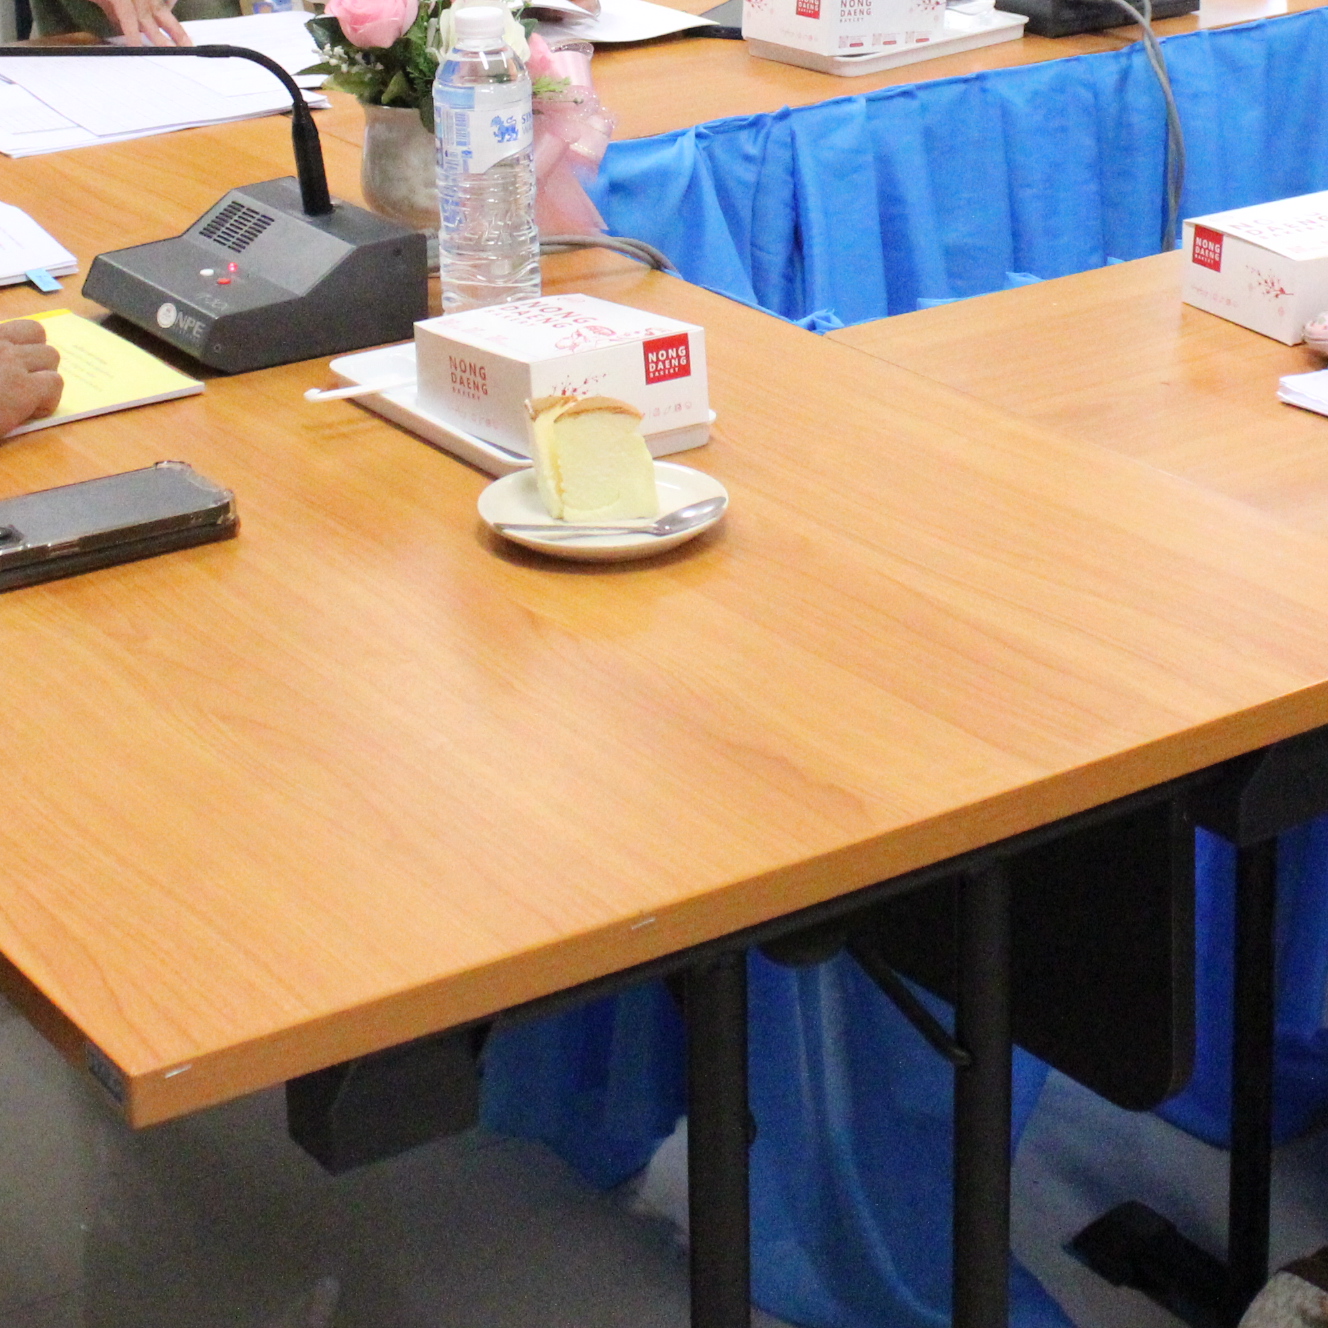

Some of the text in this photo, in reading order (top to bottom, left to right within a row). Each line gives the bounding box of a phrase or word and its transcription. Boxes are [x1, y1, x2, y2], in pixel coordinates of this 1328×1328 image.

[798, 2, 819, 12] DAENG
[840, 8, 872, 18] DAENG
[1195, 236, 1221, 254] NONG
[1195, 245, 1220, 262] DAENG
[499, 305, 573, 328] DAENG
[519, 301, 599, 324] NONG
[173, 312, 207, 339] NPE
[648, 346, 687, 363] NONG
[449, 355, 487, 381] NONG
[649, 357, 687, 372] DAENG
[450, 372, 488, 395] DAENG
